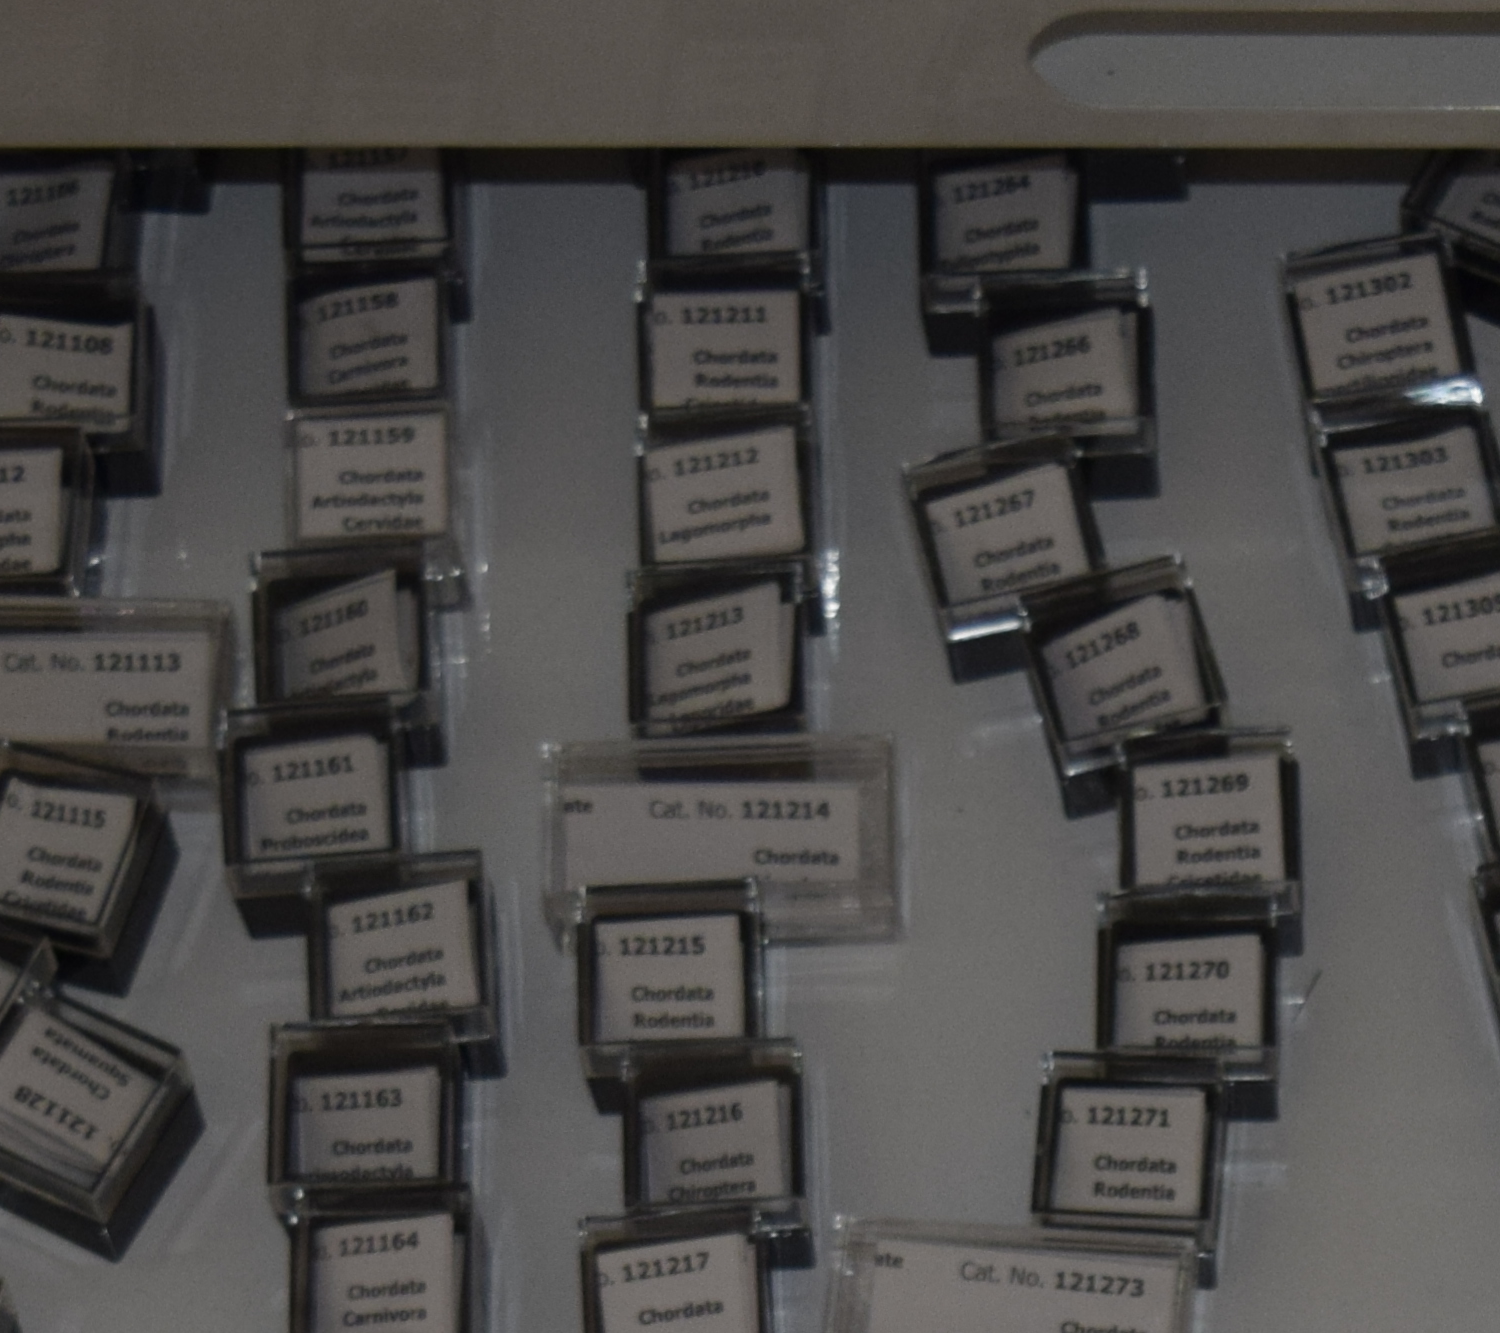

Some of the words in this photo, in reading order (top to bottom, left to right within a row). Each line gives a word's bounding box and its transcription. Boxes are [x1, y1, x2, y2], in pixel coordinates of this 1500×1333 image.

[1327, 272, 1411, 304] 121302
[675, 448, 757, 476] 121212
[95, 653, 180, 672] 121113
[273, 755, 353, 782] 121161
[1162, 774, 1248, 798] 121269
[743, 800, 830, 819] 121214
[353, 902, 433, 933] 121162
[620, 935, 704, 956] 121215
[1146, 960, 1229, 981] 121270
[321, 1089, 402, 1111] 121163
[1088, 1106, 1169, 1128] 121271
[623, 1252, 709, 1282] 121217
[1055, 1271, 1144, 1297] 121273
